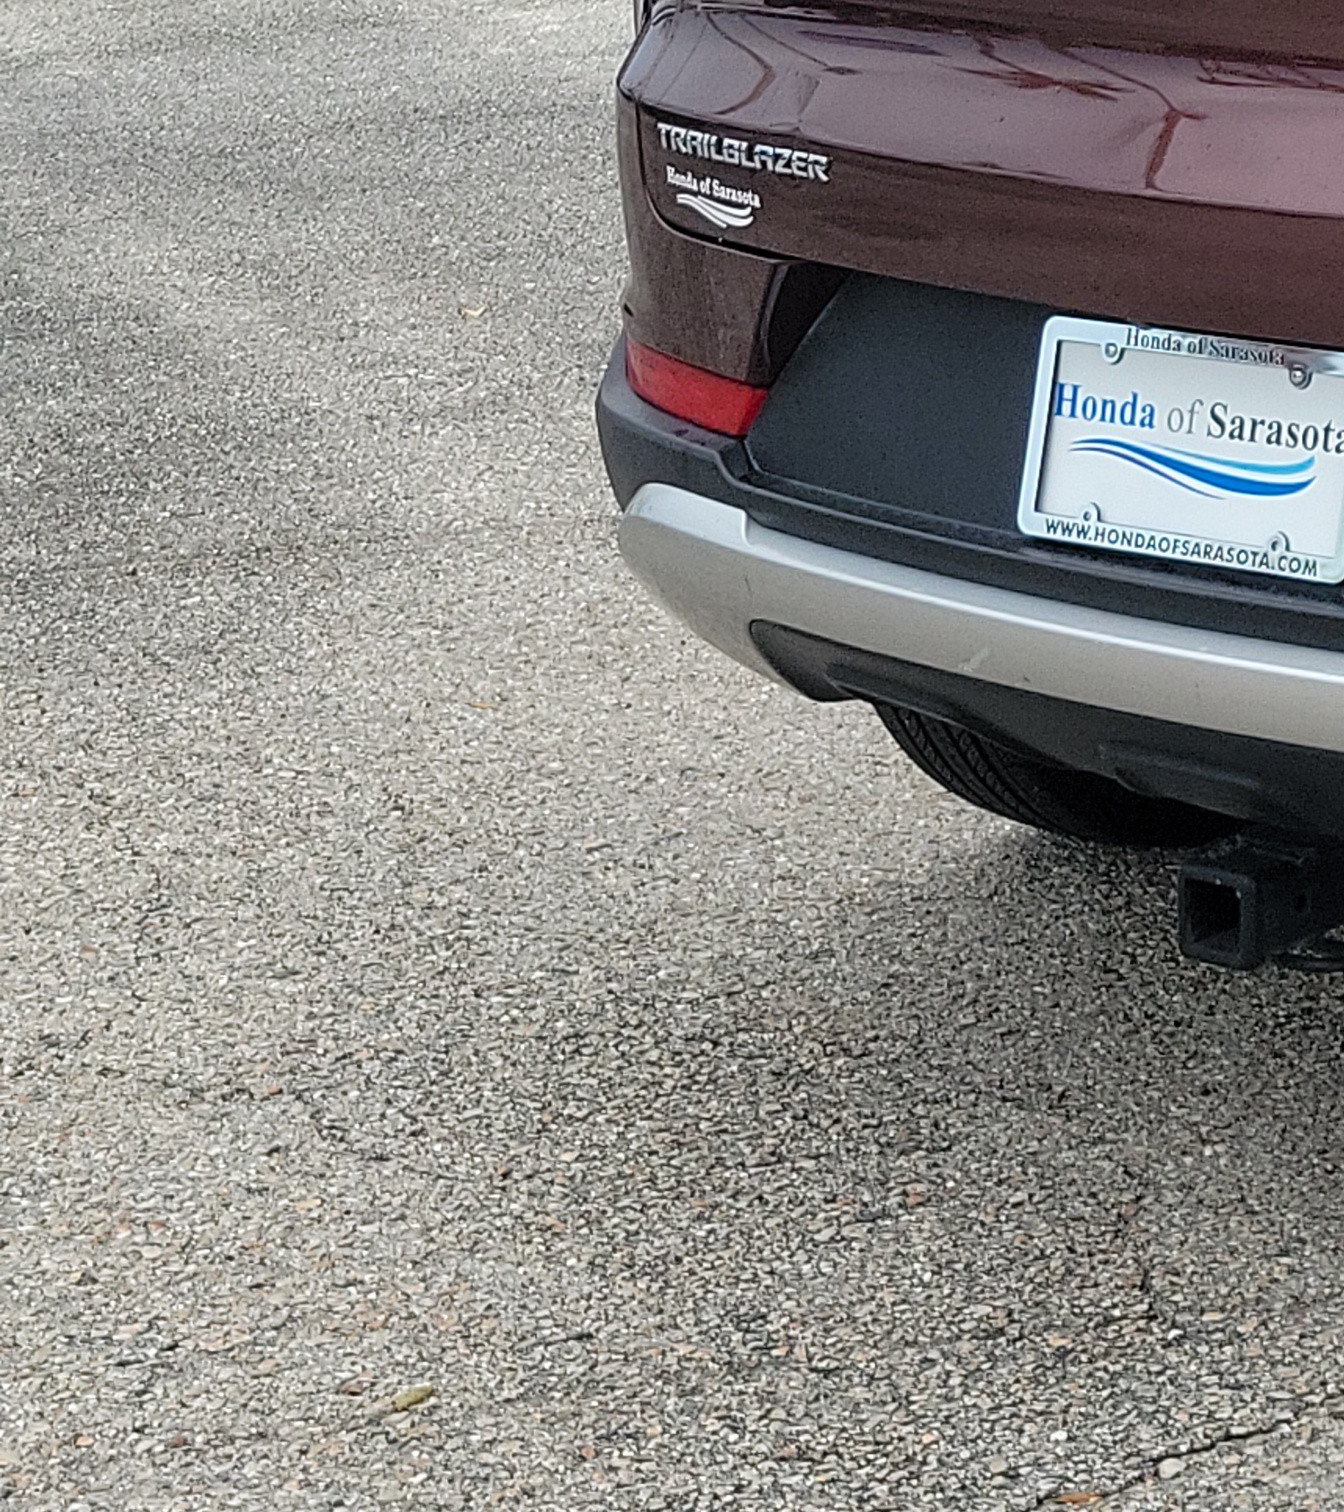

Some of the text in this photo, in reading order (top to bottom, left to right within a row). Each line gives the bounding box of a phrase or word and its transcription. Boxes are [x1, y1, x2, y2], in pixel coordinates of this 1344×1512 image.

[656, 122, 830, 183] TRAILBLAZER
[666, 165, 761, 208] Honda of Sarasota
[1125, 326, 1285, 366] Honda of Sarasota
[1054, 381, 1156, 429] Honda
[1167, 398, 1204, 434] of
[1045, 517, 1318, 578] WWW.HONDAOFSARASOTA.COM
